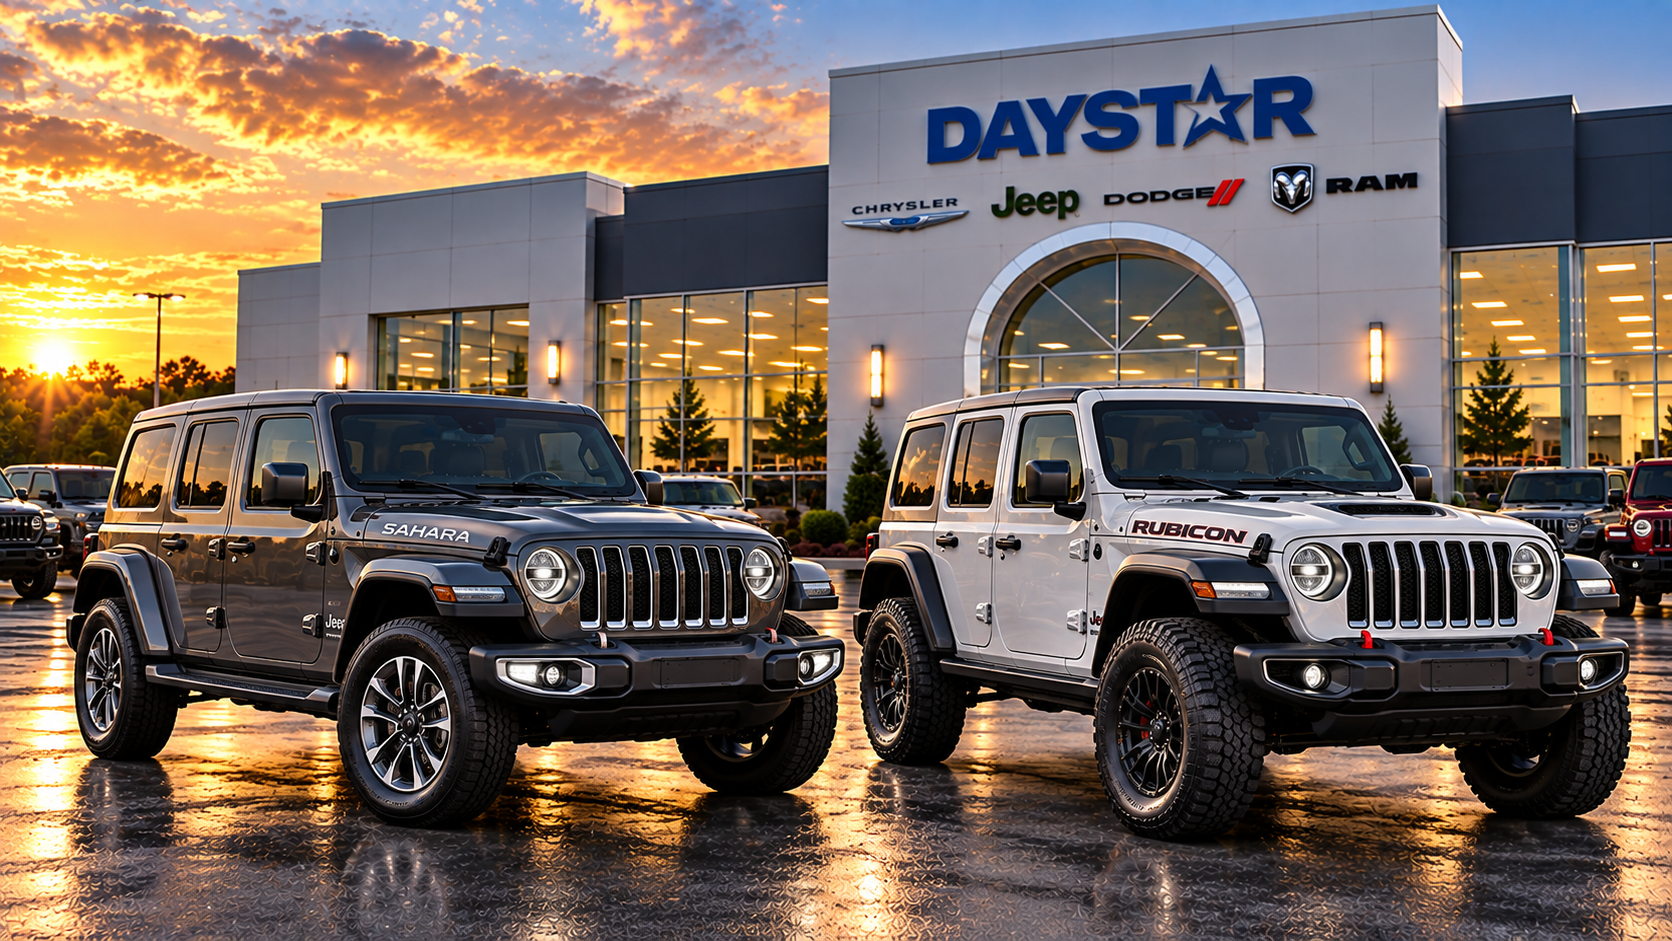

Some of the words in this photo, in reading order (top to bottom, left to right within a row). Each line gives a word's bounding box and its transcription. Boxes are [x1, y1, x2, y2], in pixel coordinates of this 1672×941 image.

[1326, 172, 1418, 194] RAM
[851, 198, 959, 215] CHRYSLER
[991, 186, 1080, 220] Jeep
[1103, 186, 1215, 206] DODGE
[381, 522, 470, 543] SAHARA
[1131, 519, 1248, 544] RUBICON
